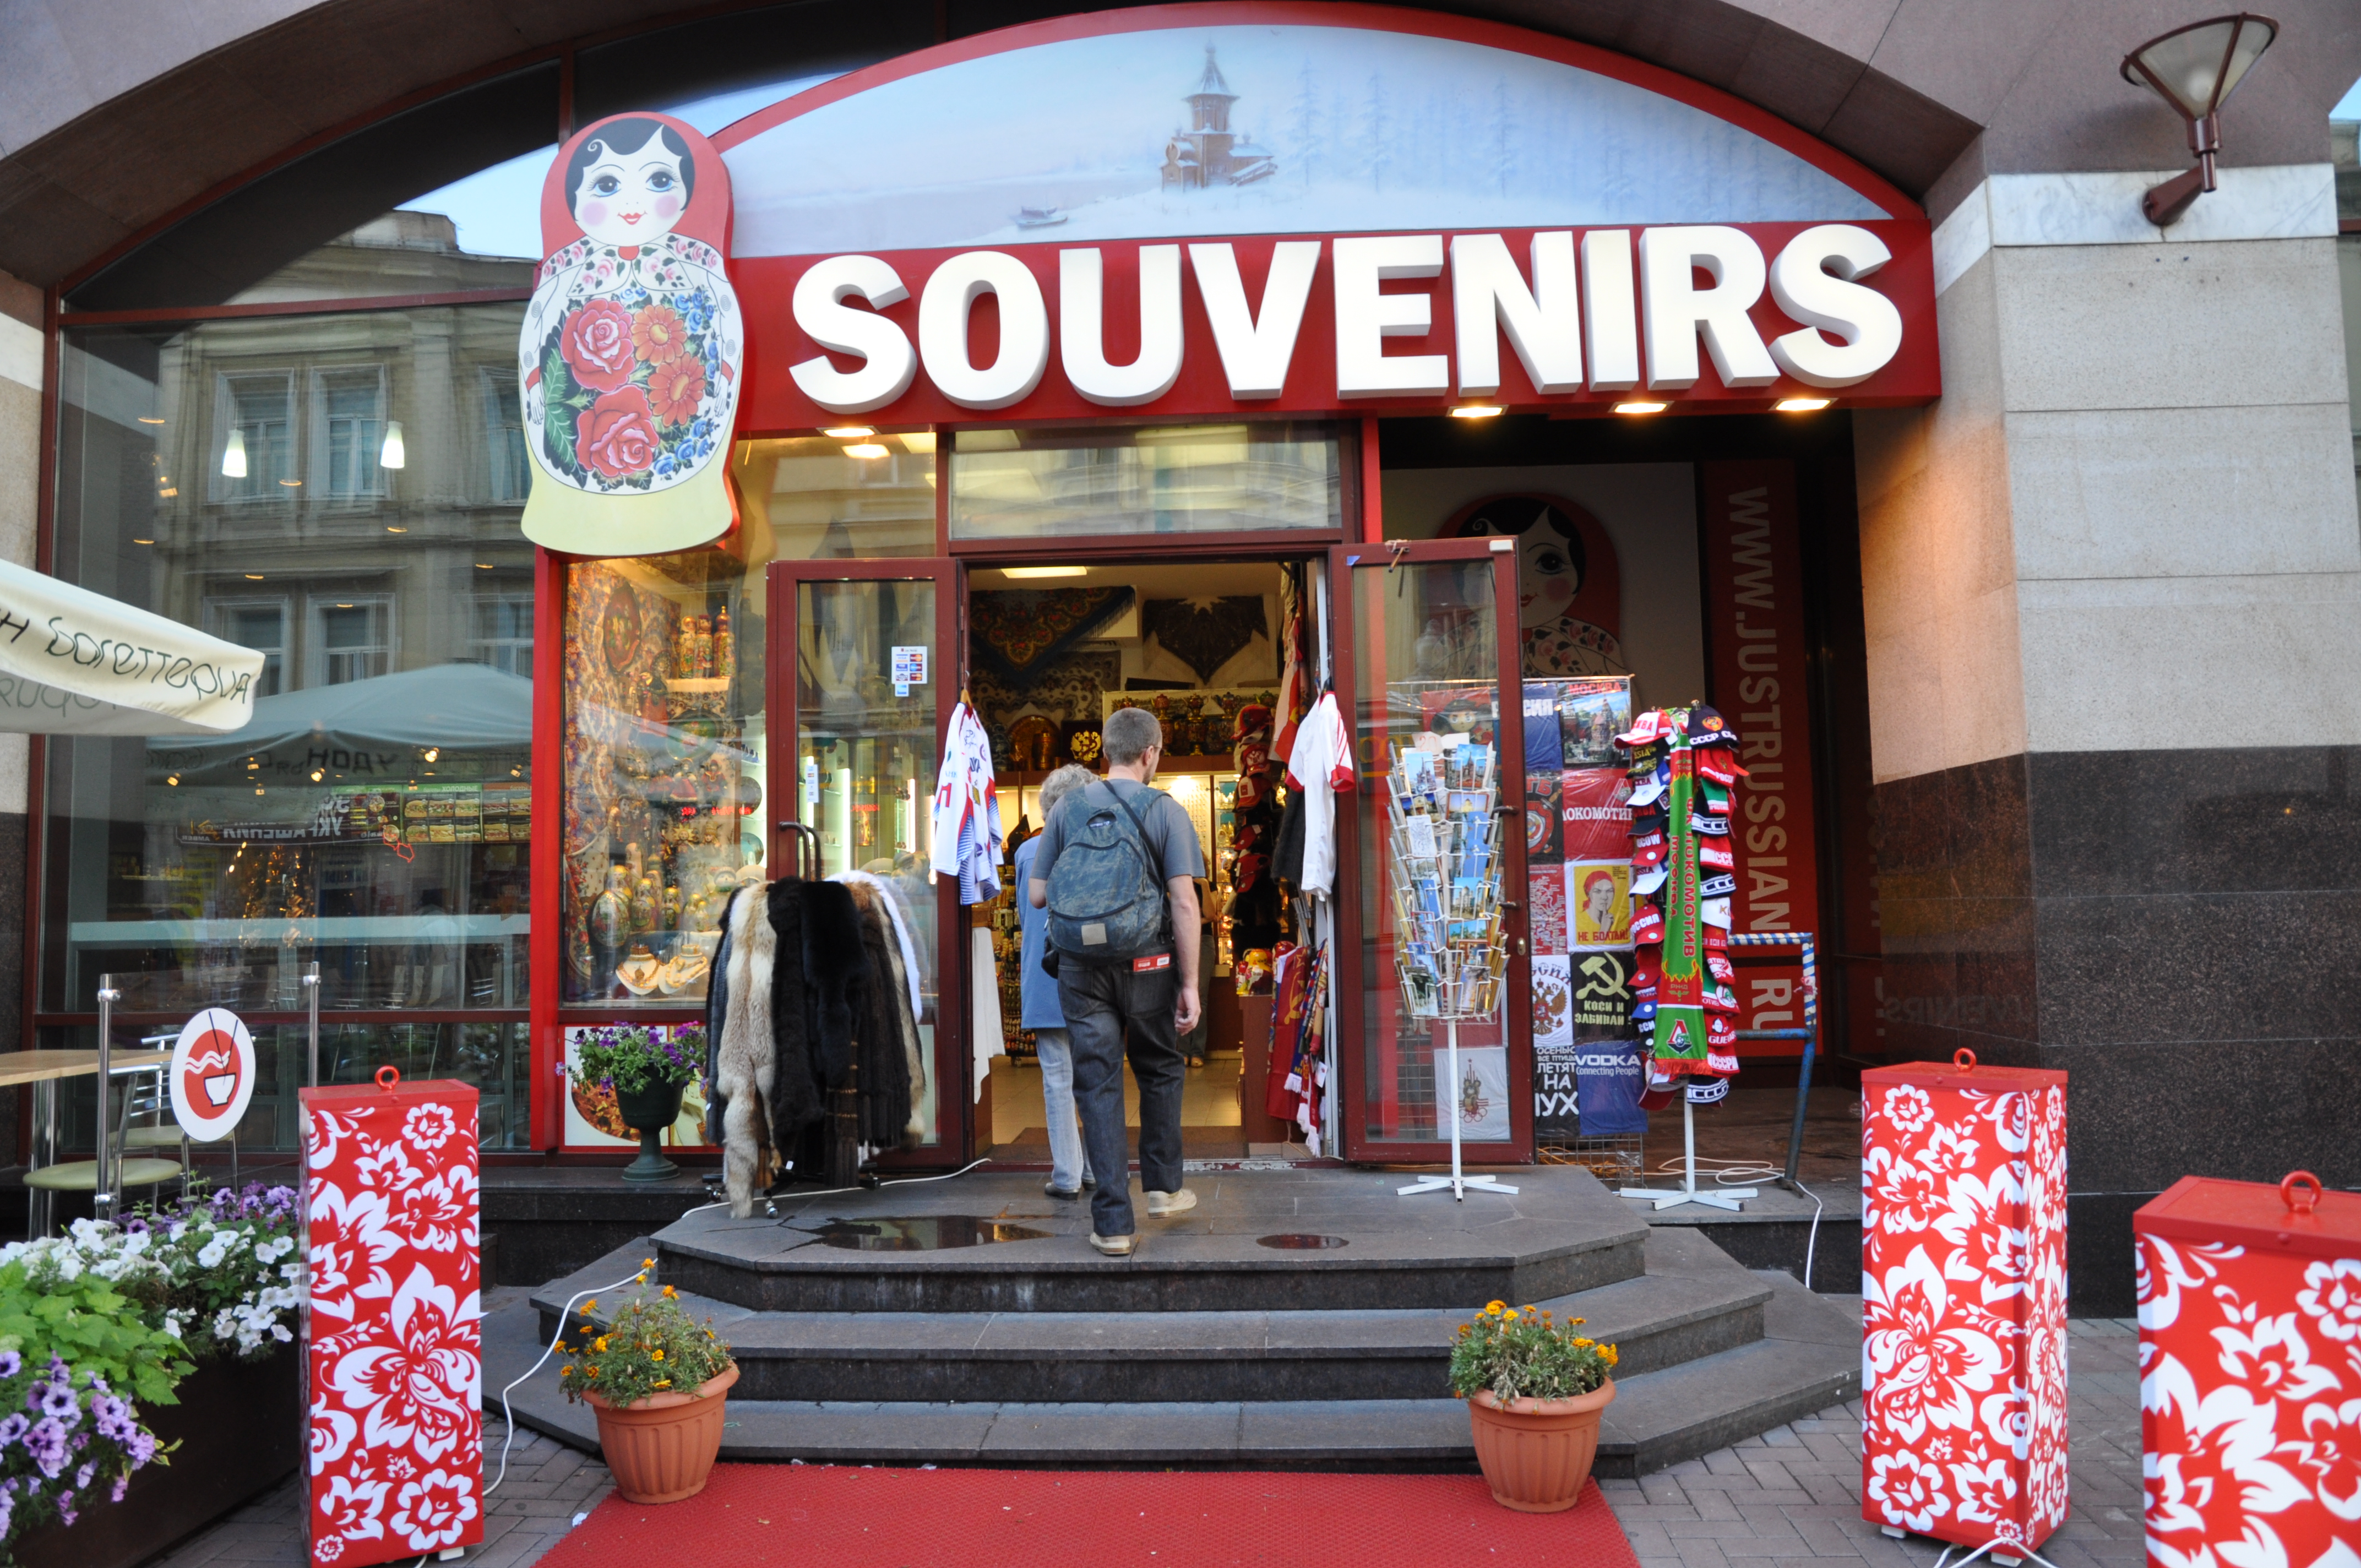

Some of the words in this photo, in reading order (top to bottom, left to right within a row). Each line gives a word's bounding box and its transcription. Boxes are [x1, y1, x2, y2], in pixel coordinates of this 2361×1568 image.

[788, 224, 1903, 413] SOUVENIRS
[1569, 682, 1622, 694] МОСКВА
[1526, 777, 1553, 796] ГБ
[1715, 852, 1733, 867] ССС
[1578, 931, 1589, 941] НЕ
[1584, 1000, 1612, 1012] КОСИ
[1617, 1002, 1624, 1012] И
[1575, 1054, 1641, 1066] VODKA
[1537, 1062, 1576, 1074] ЛЕТЯТ
[1576, 1066, 1614, 1076] Connecting
[1615, 1066, 1639, 1076] People
[1544, 1074, 1571, 1090] НА
